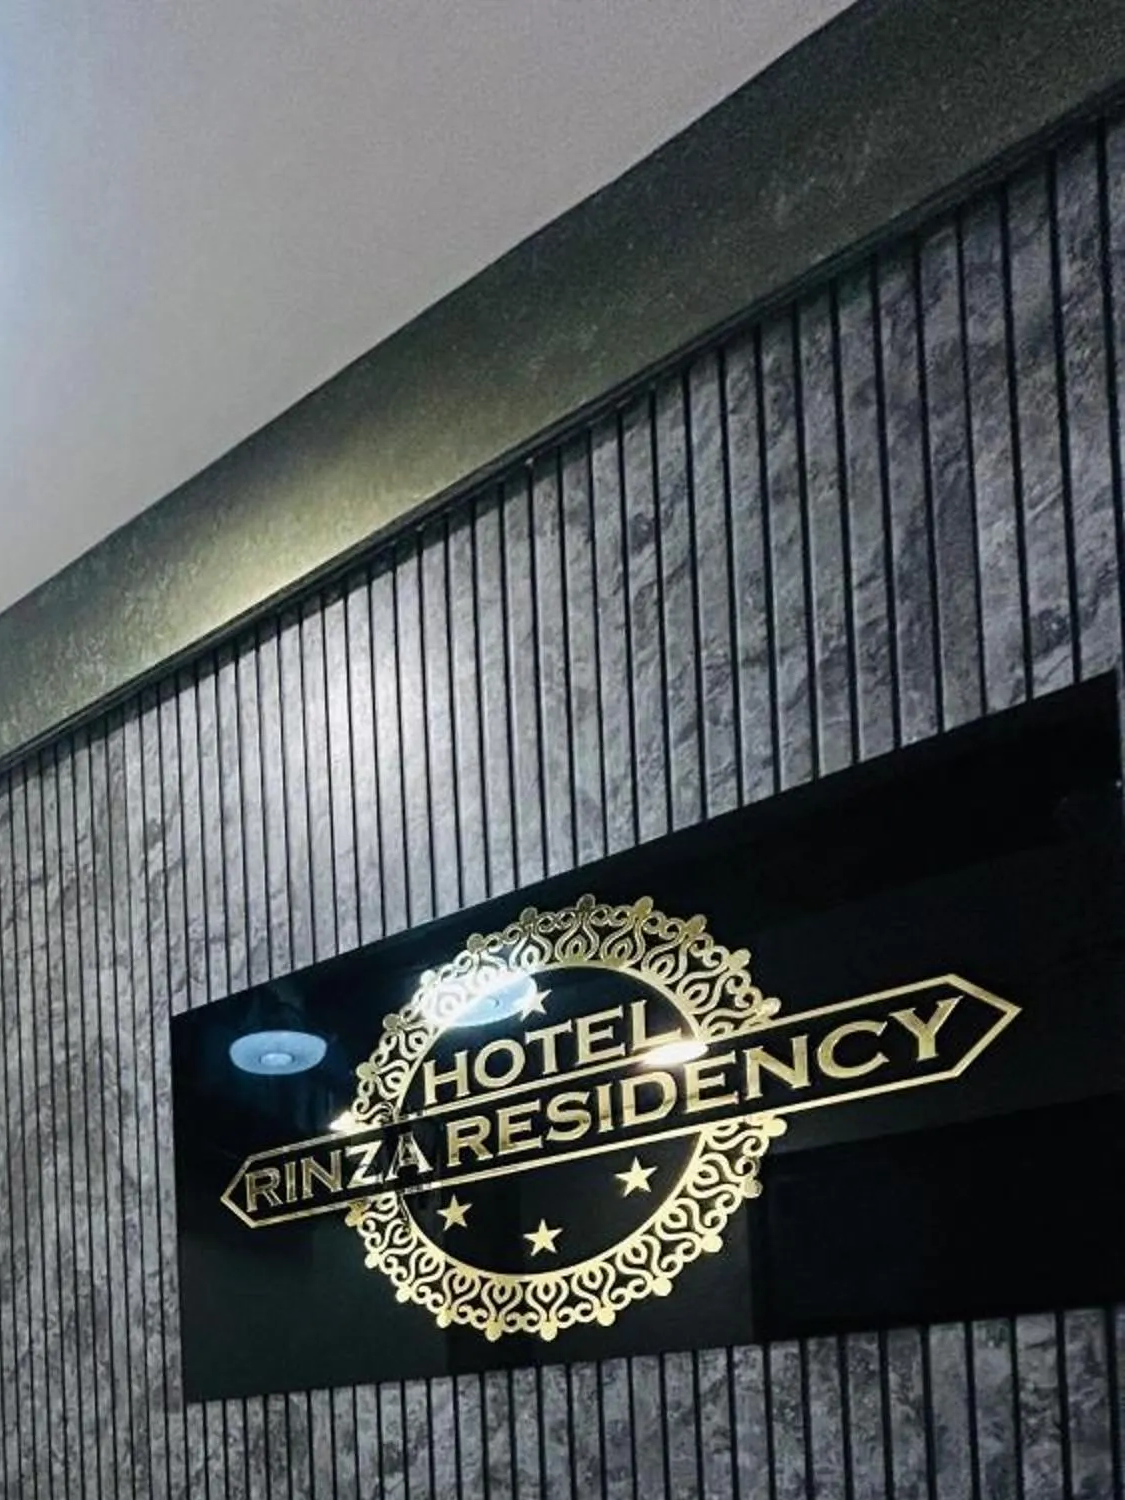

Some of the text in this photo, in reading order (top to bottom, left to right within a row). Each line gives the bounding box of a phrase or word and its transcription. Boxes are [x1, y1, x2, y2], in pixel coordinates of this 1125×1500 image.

[245, 995, 964, 1213] RINZA RESIDENCY
[423, 1000, 683, 1105] HOTEL
